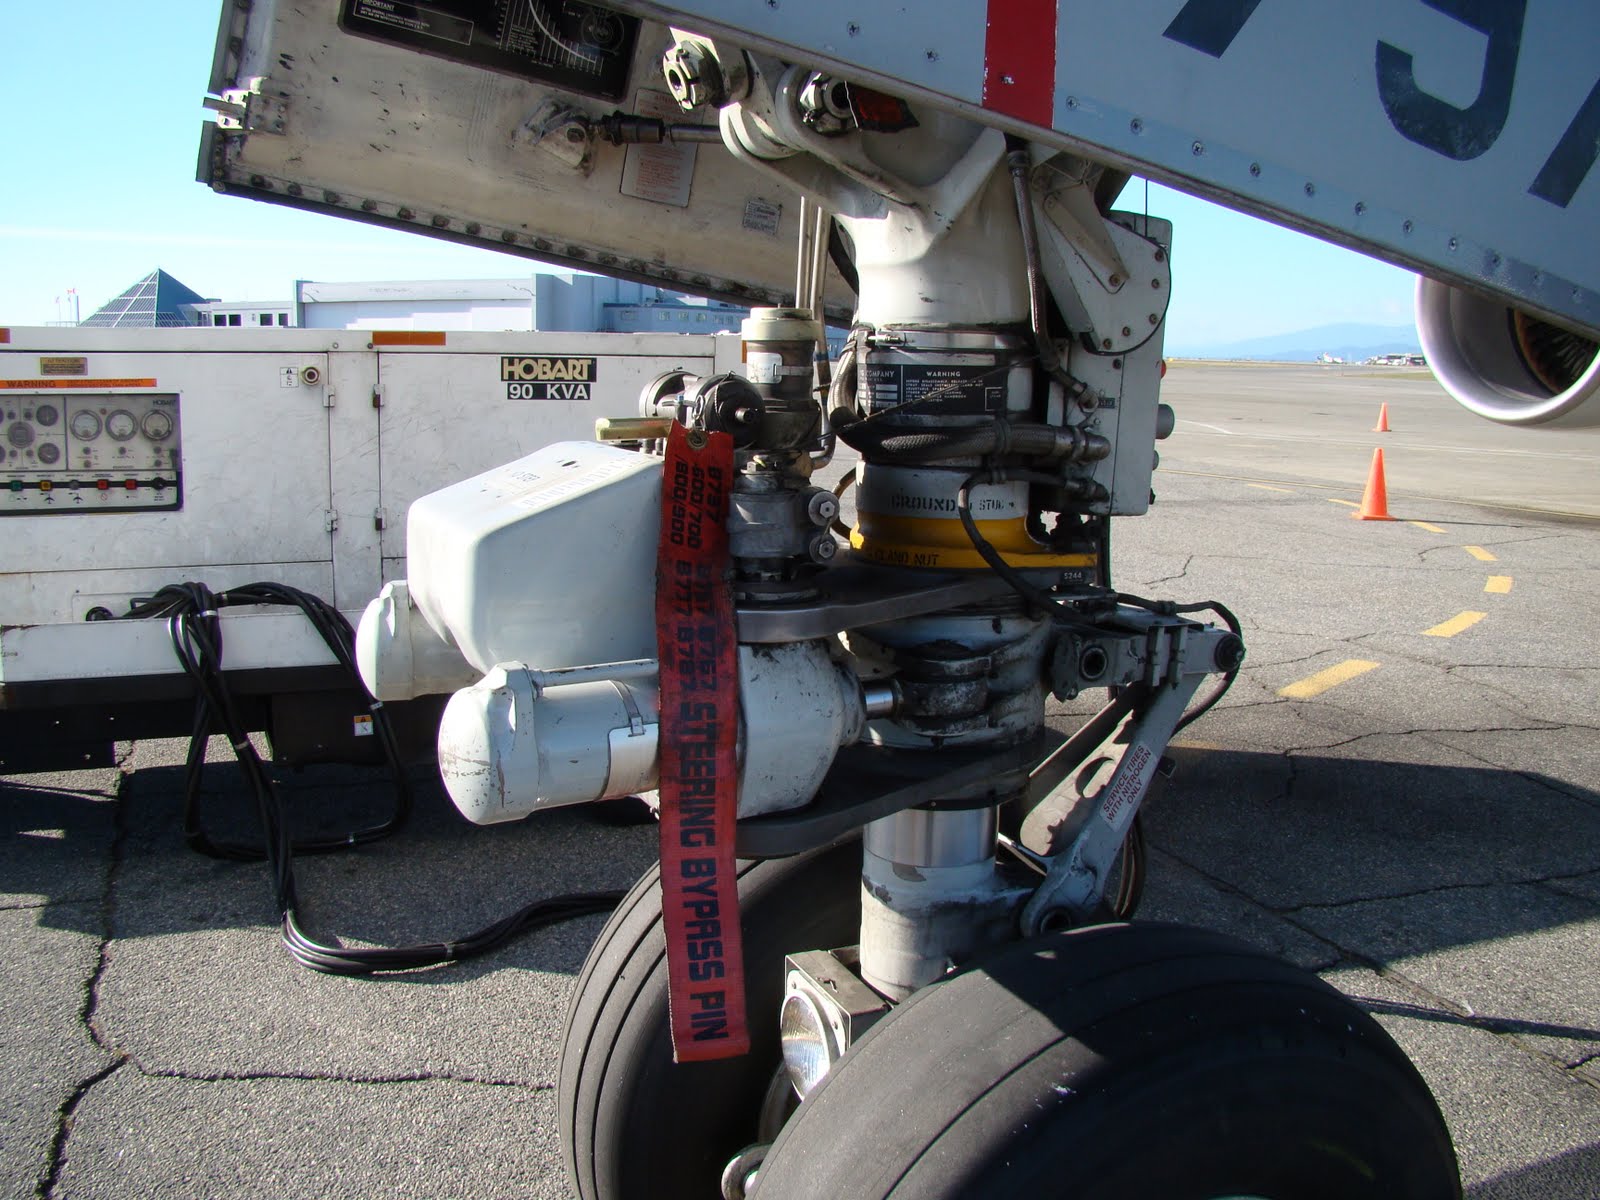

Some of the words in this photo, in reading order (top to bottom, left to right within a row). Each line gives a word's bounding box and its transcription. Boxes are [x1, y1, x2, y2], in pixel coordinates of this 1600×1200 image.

[7, 380, 57, 388] WARNING
[503, 359, 592, 380] HOBART
[509, 384, 534, 399] 90
[546, 384, 589, 399] KVA
[914, 553, 939, 566] NUT
[679, 702, 717, 848] STEERING
[1103, 772, 1129, 813] SERVICE
[1126, 745, 1145, 772] TIRES
[1106, 797, 1124, 821] WITH
[1122, 750, 1152, 797] NITROGEN
[1127, 779, 1143, 804] ONLY
[680, 857, 725, 983] BYPASS
[690, 990, 729, 1042] PIN
